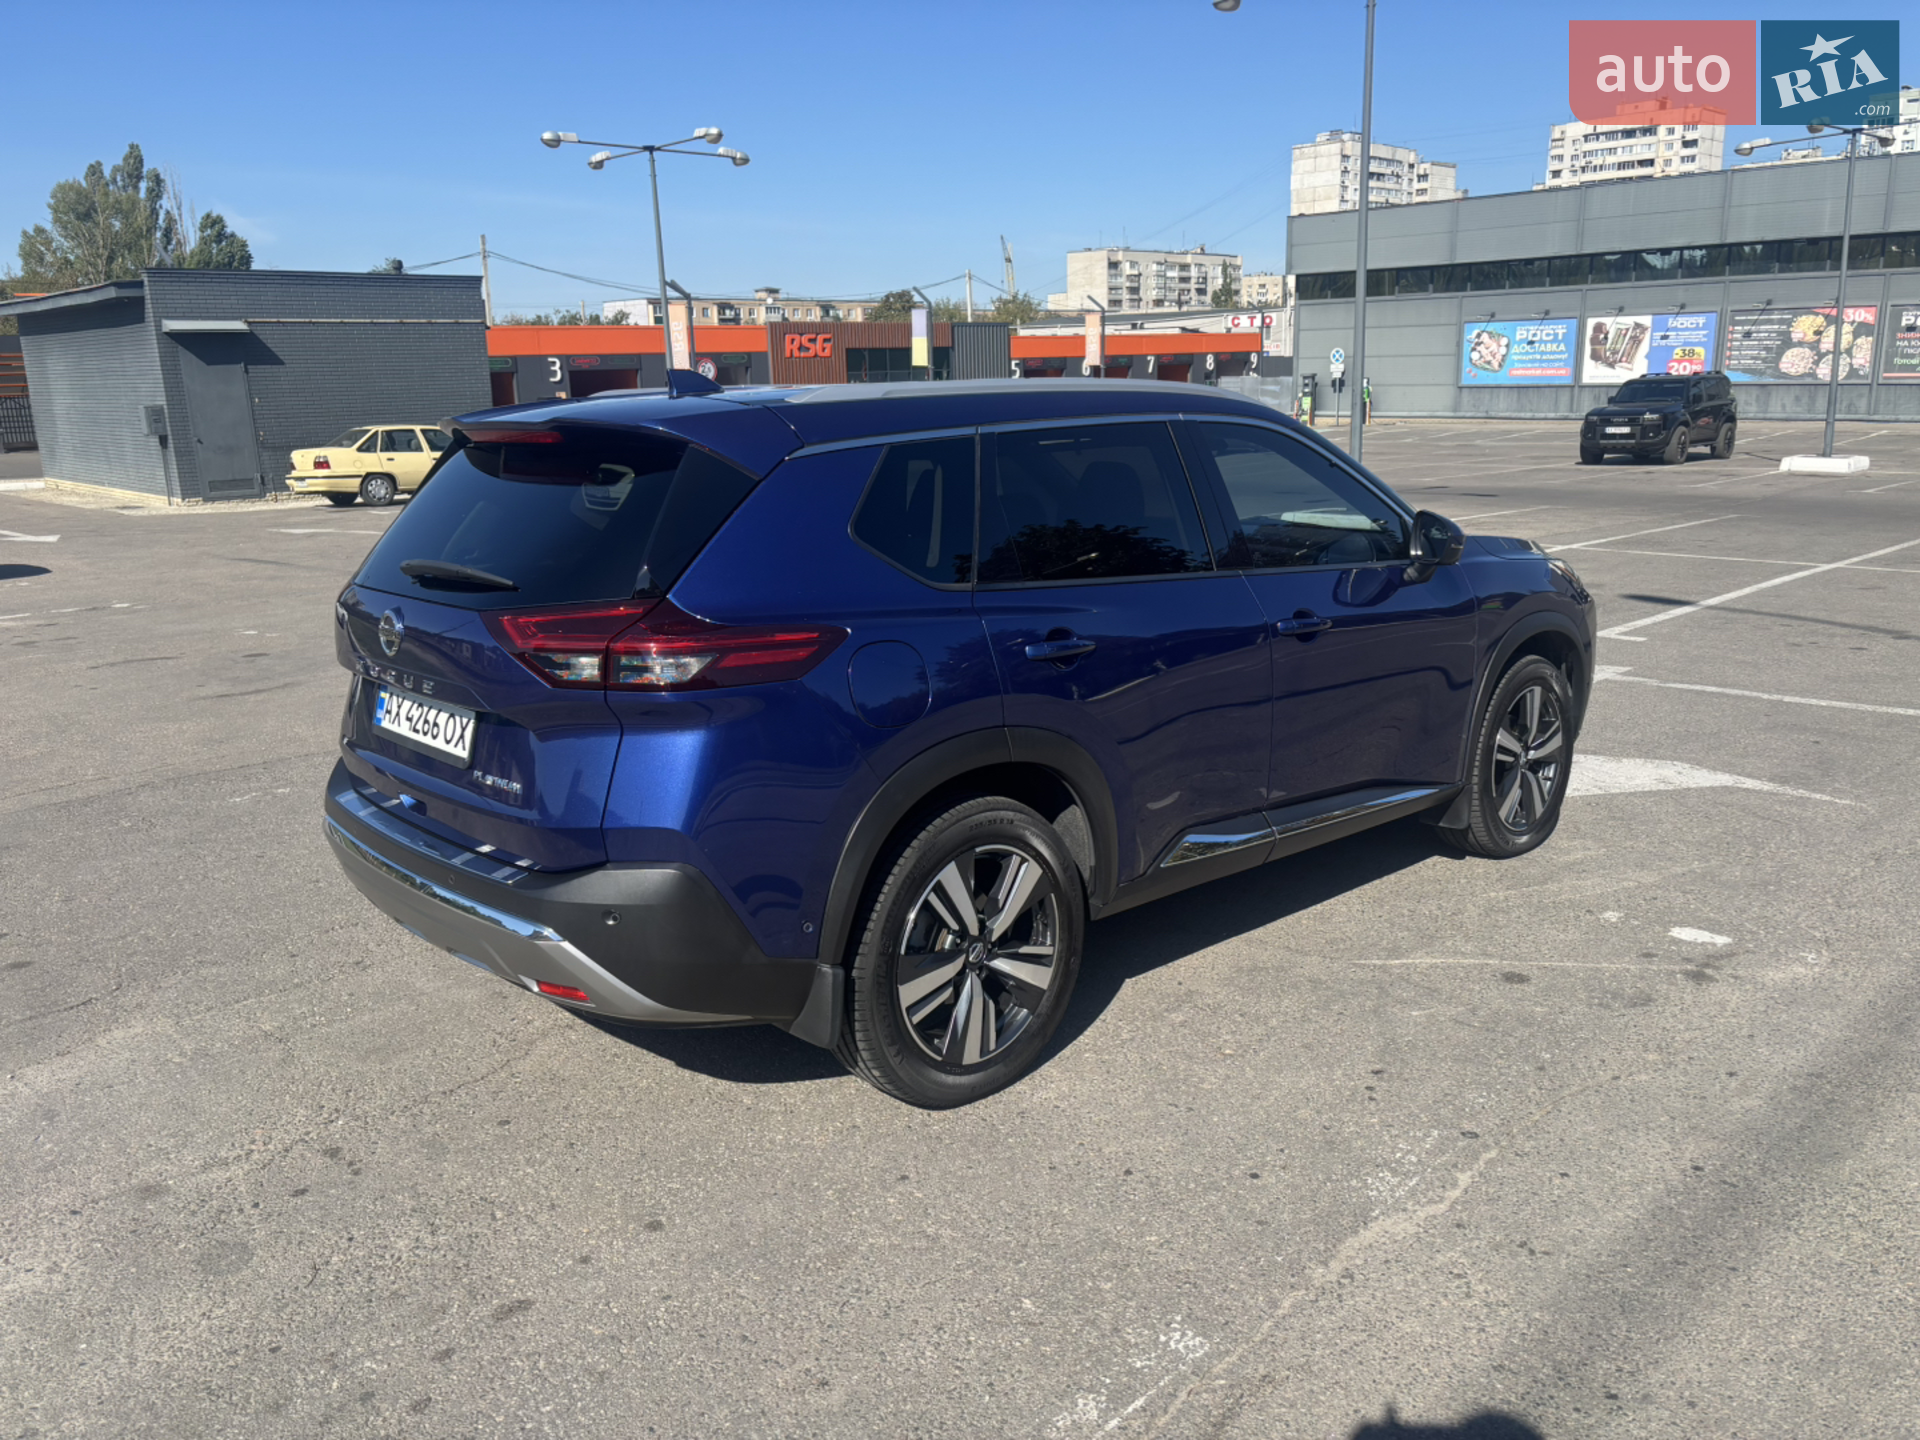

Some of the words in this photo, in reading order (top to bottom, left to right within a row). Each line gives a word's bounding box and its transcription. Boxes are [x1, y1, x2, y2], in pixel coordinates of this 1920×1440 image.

[1515, 329, 1568, 341] РОСТ
[785, 333, 833, 358] RSG
[1511, 343, 1566, 353] ДОСТАВКА
[1082, 358, 1090, 376] 6
[1147, 356, 1155, 373] 7
[1206, 354, 1214, 370] 8
[1250, 352, 1258, 369] 9
[547, 357, 562, 382] 3
[1011, 360, 1020, 379] 5
[384, 692, 405, 727] AX
[405, 700, 441, 741] 4266
[443, 712, 472, 751] OX
